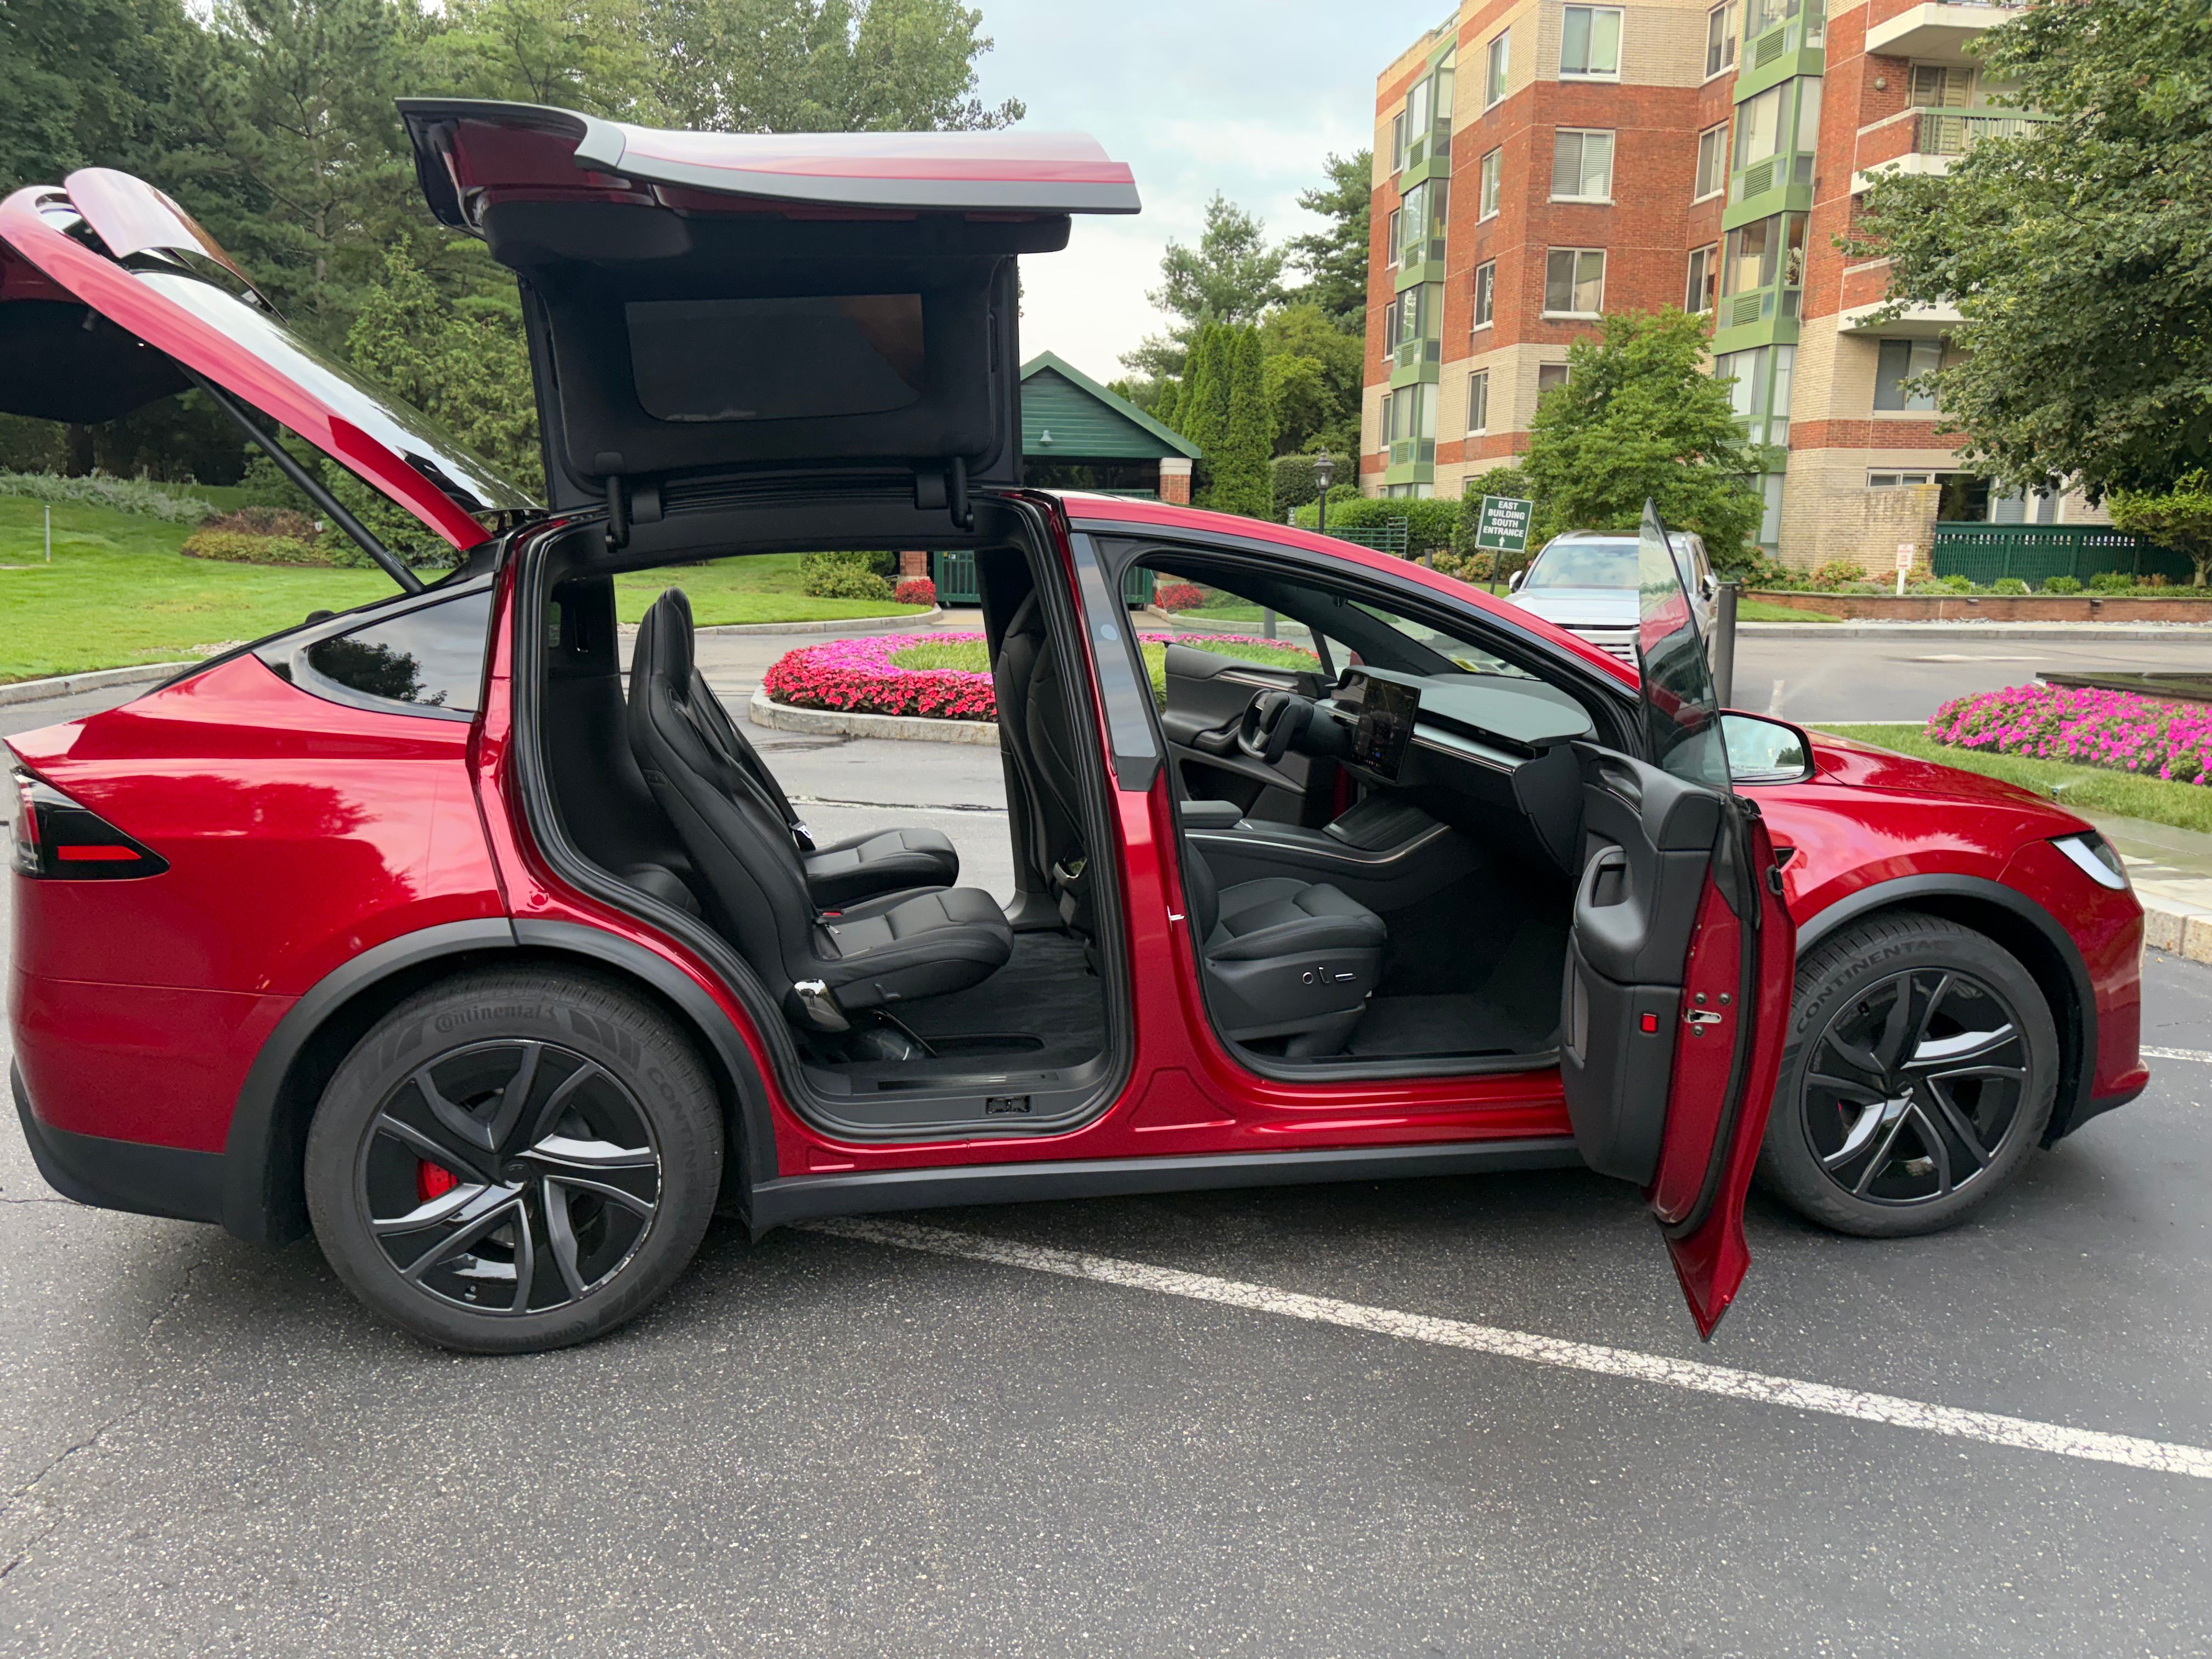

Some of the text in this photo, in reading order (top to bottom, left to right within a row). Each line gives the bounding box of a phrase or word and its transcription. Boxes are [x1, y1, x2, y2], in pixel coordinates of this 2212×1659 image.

[1498, 500, 1519, 510] EAST
[1487, 509, 1525, 520] BUILDING
[1491, 518, 1519, 528] SOUTH
[1482, 526, 1525, 538] ENTRANCE
